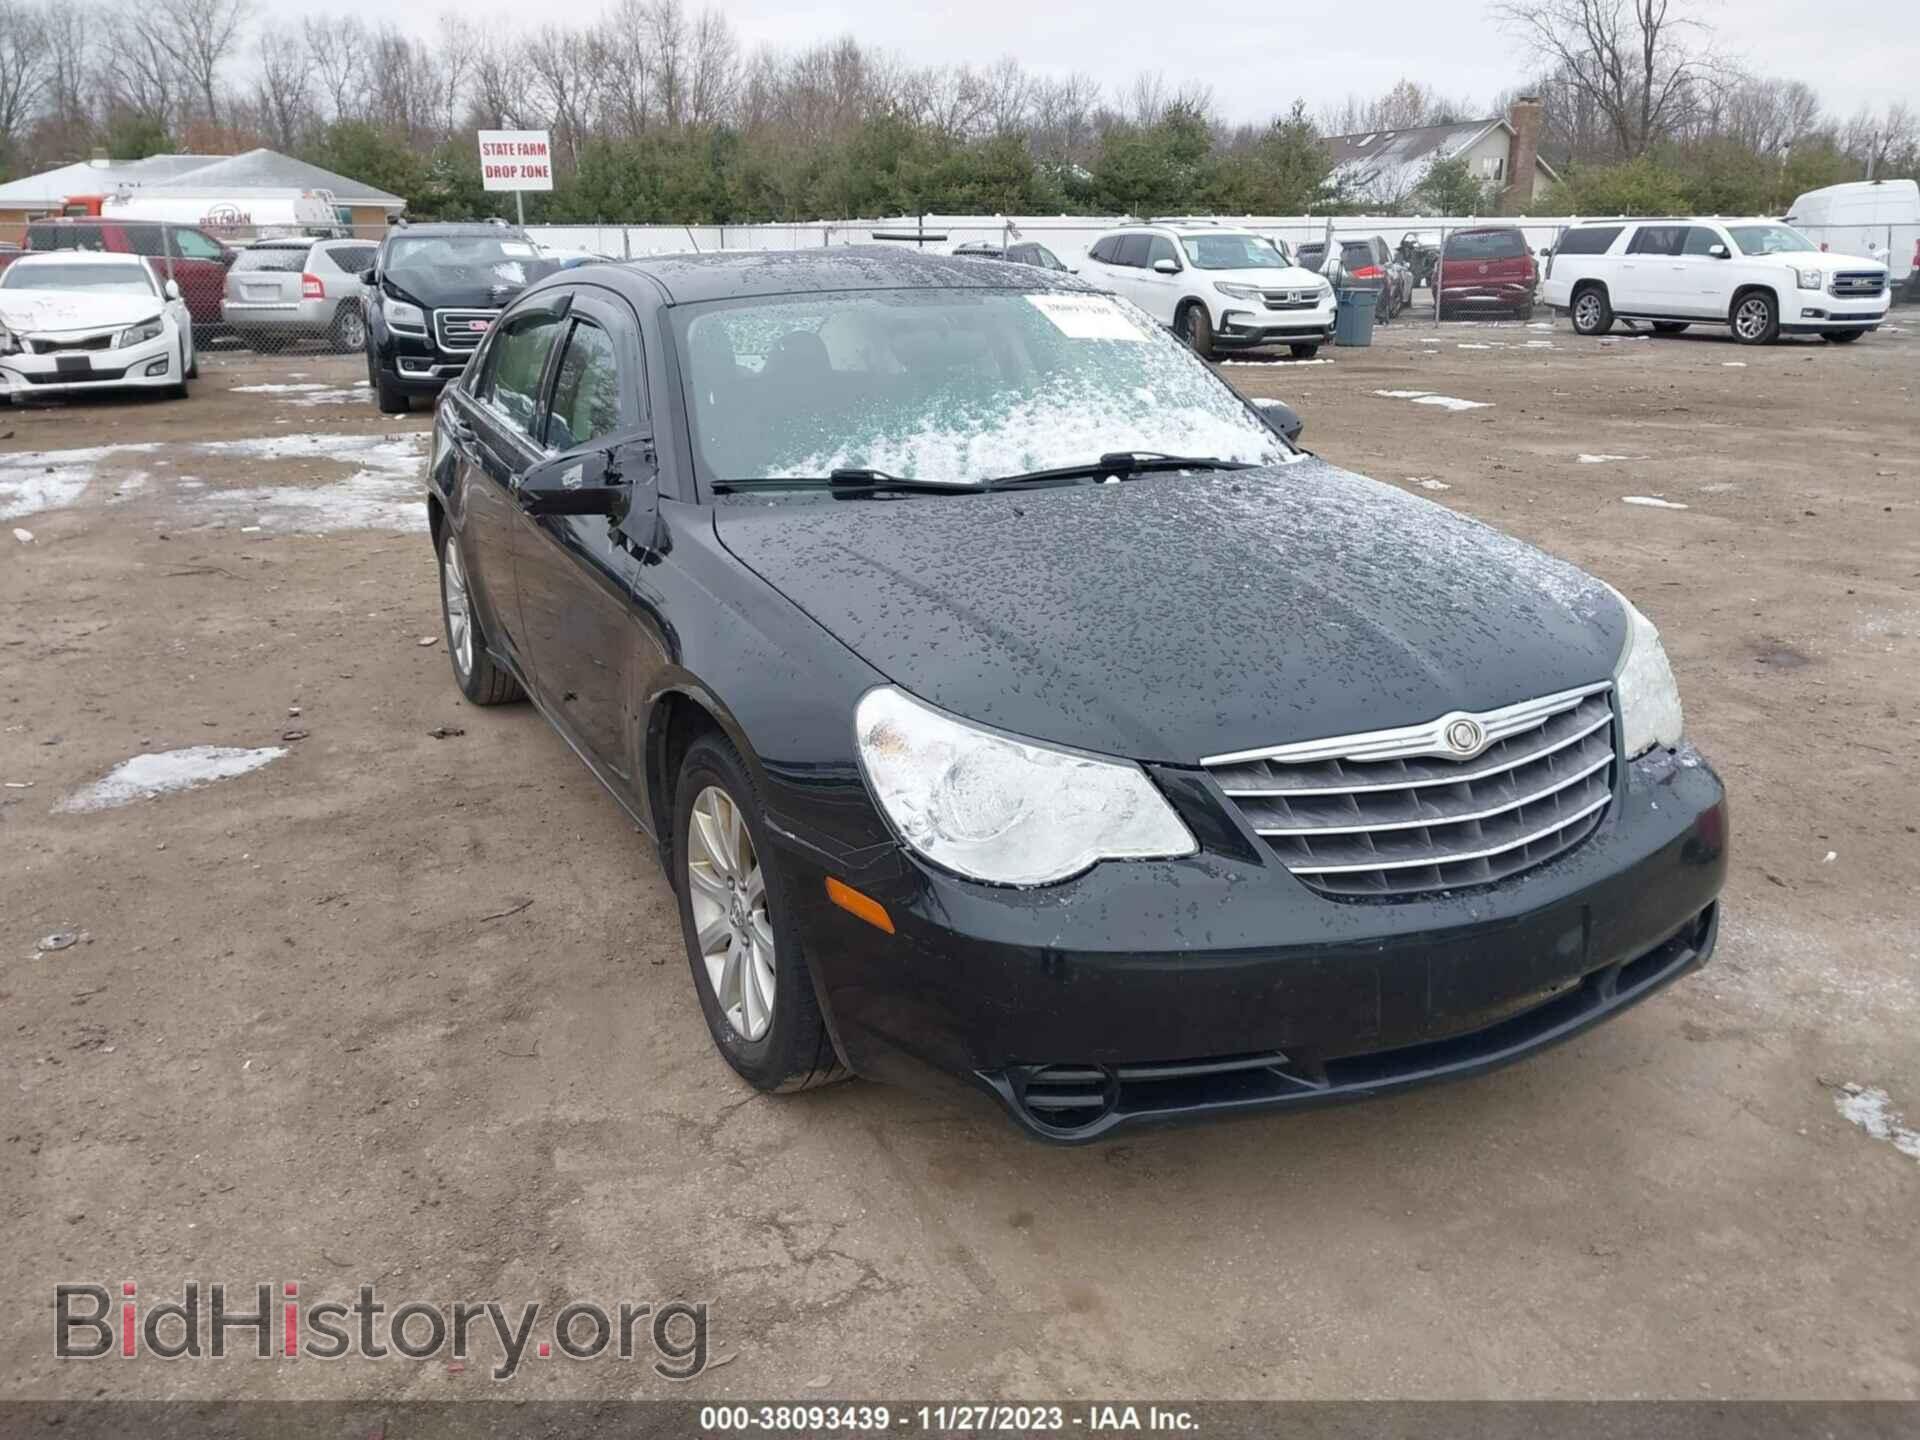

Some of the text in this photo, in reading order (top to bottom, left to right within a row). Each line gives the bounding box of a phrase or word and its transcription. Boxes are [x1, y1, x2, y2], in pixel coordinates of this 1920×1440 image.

[482, 143, 547, 156] STATE FARM
[485, 165, 549, 178] DROP ZONE
